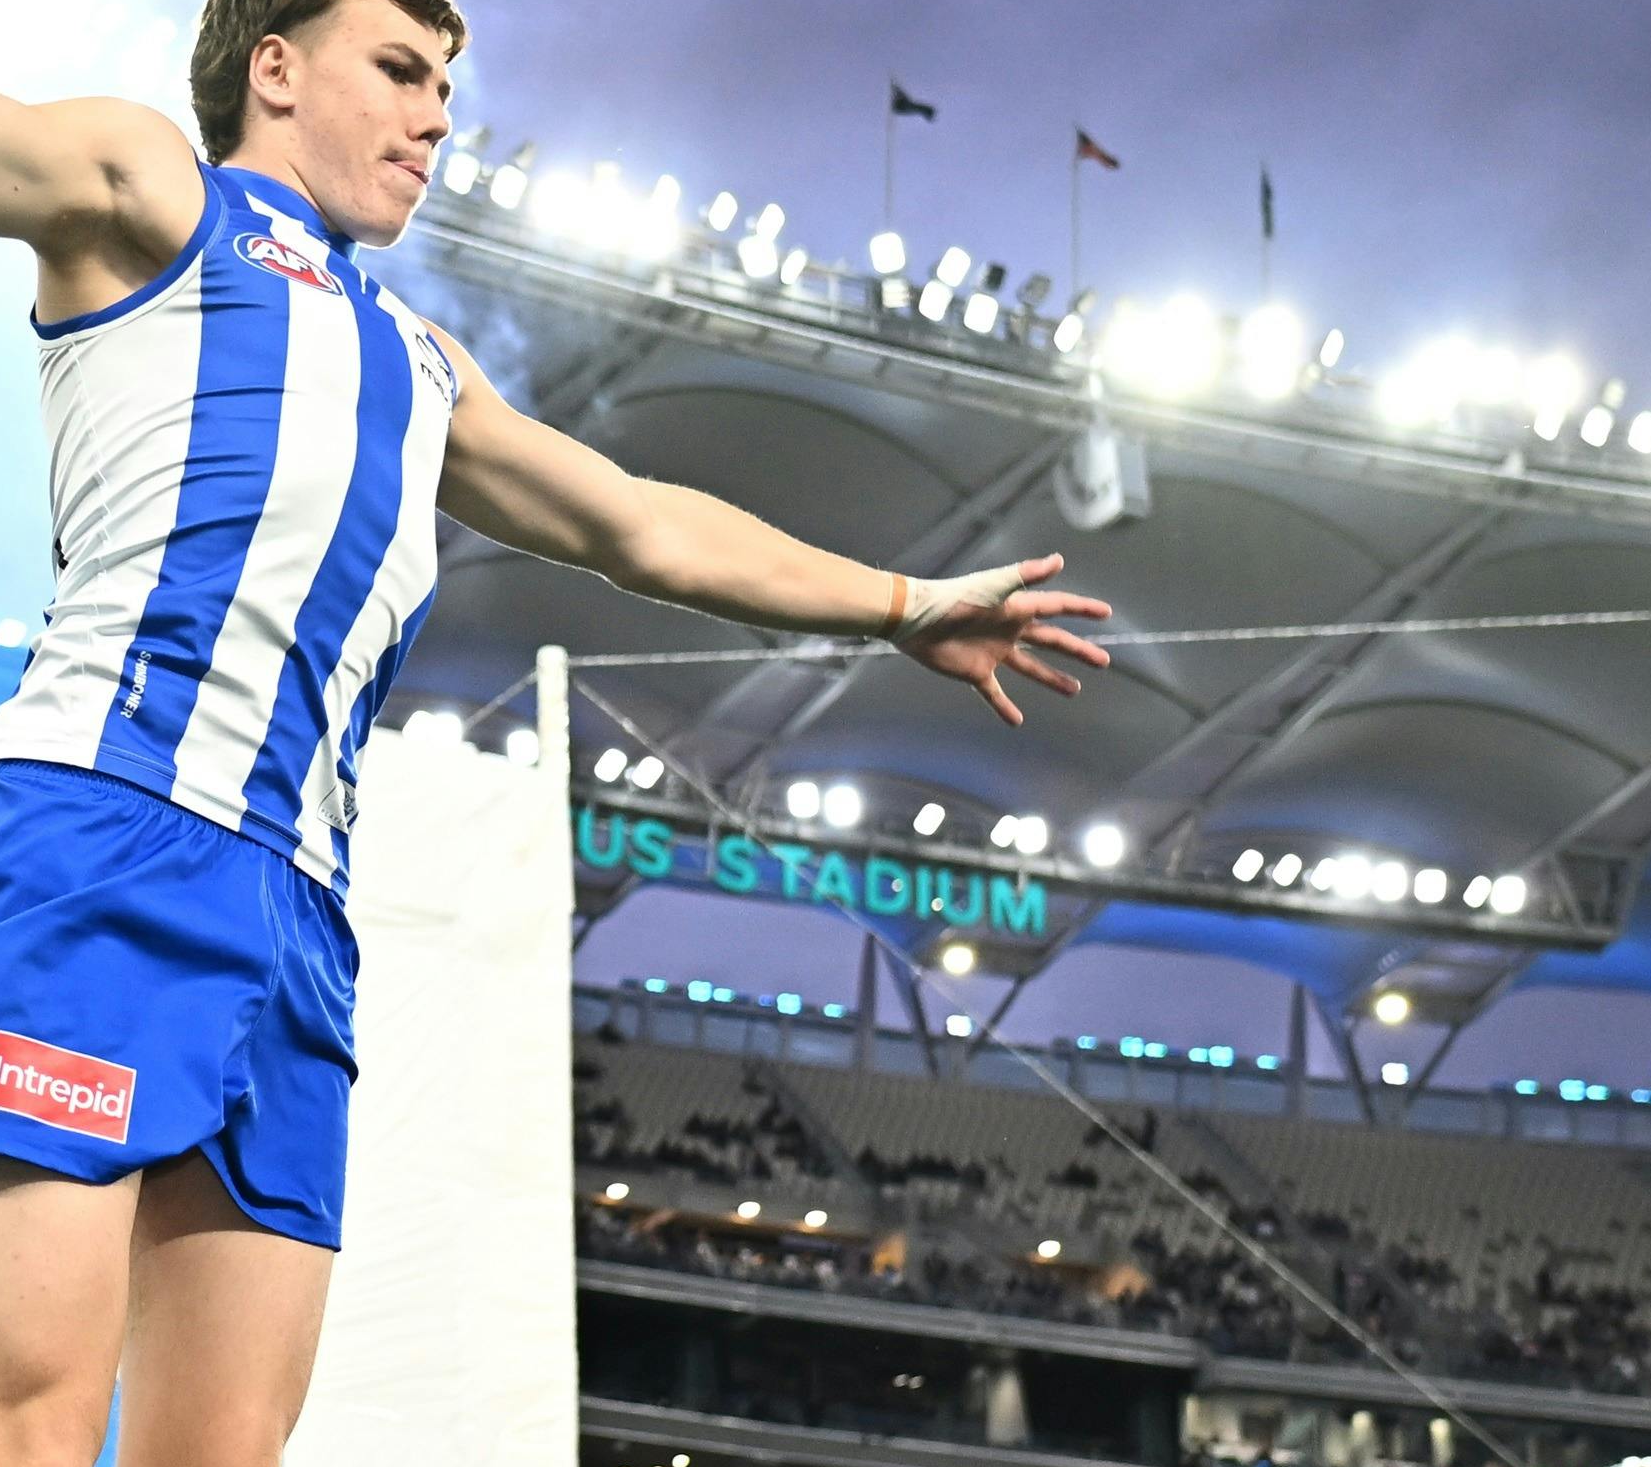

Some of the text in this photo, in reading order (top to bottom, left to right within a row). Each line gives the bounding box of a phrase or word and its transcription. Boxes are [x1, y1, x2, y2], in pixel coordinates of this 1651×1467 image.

[120, 650, 152, 719] SHINBONER
[574, 807, 1045, 933] US STADIUM
